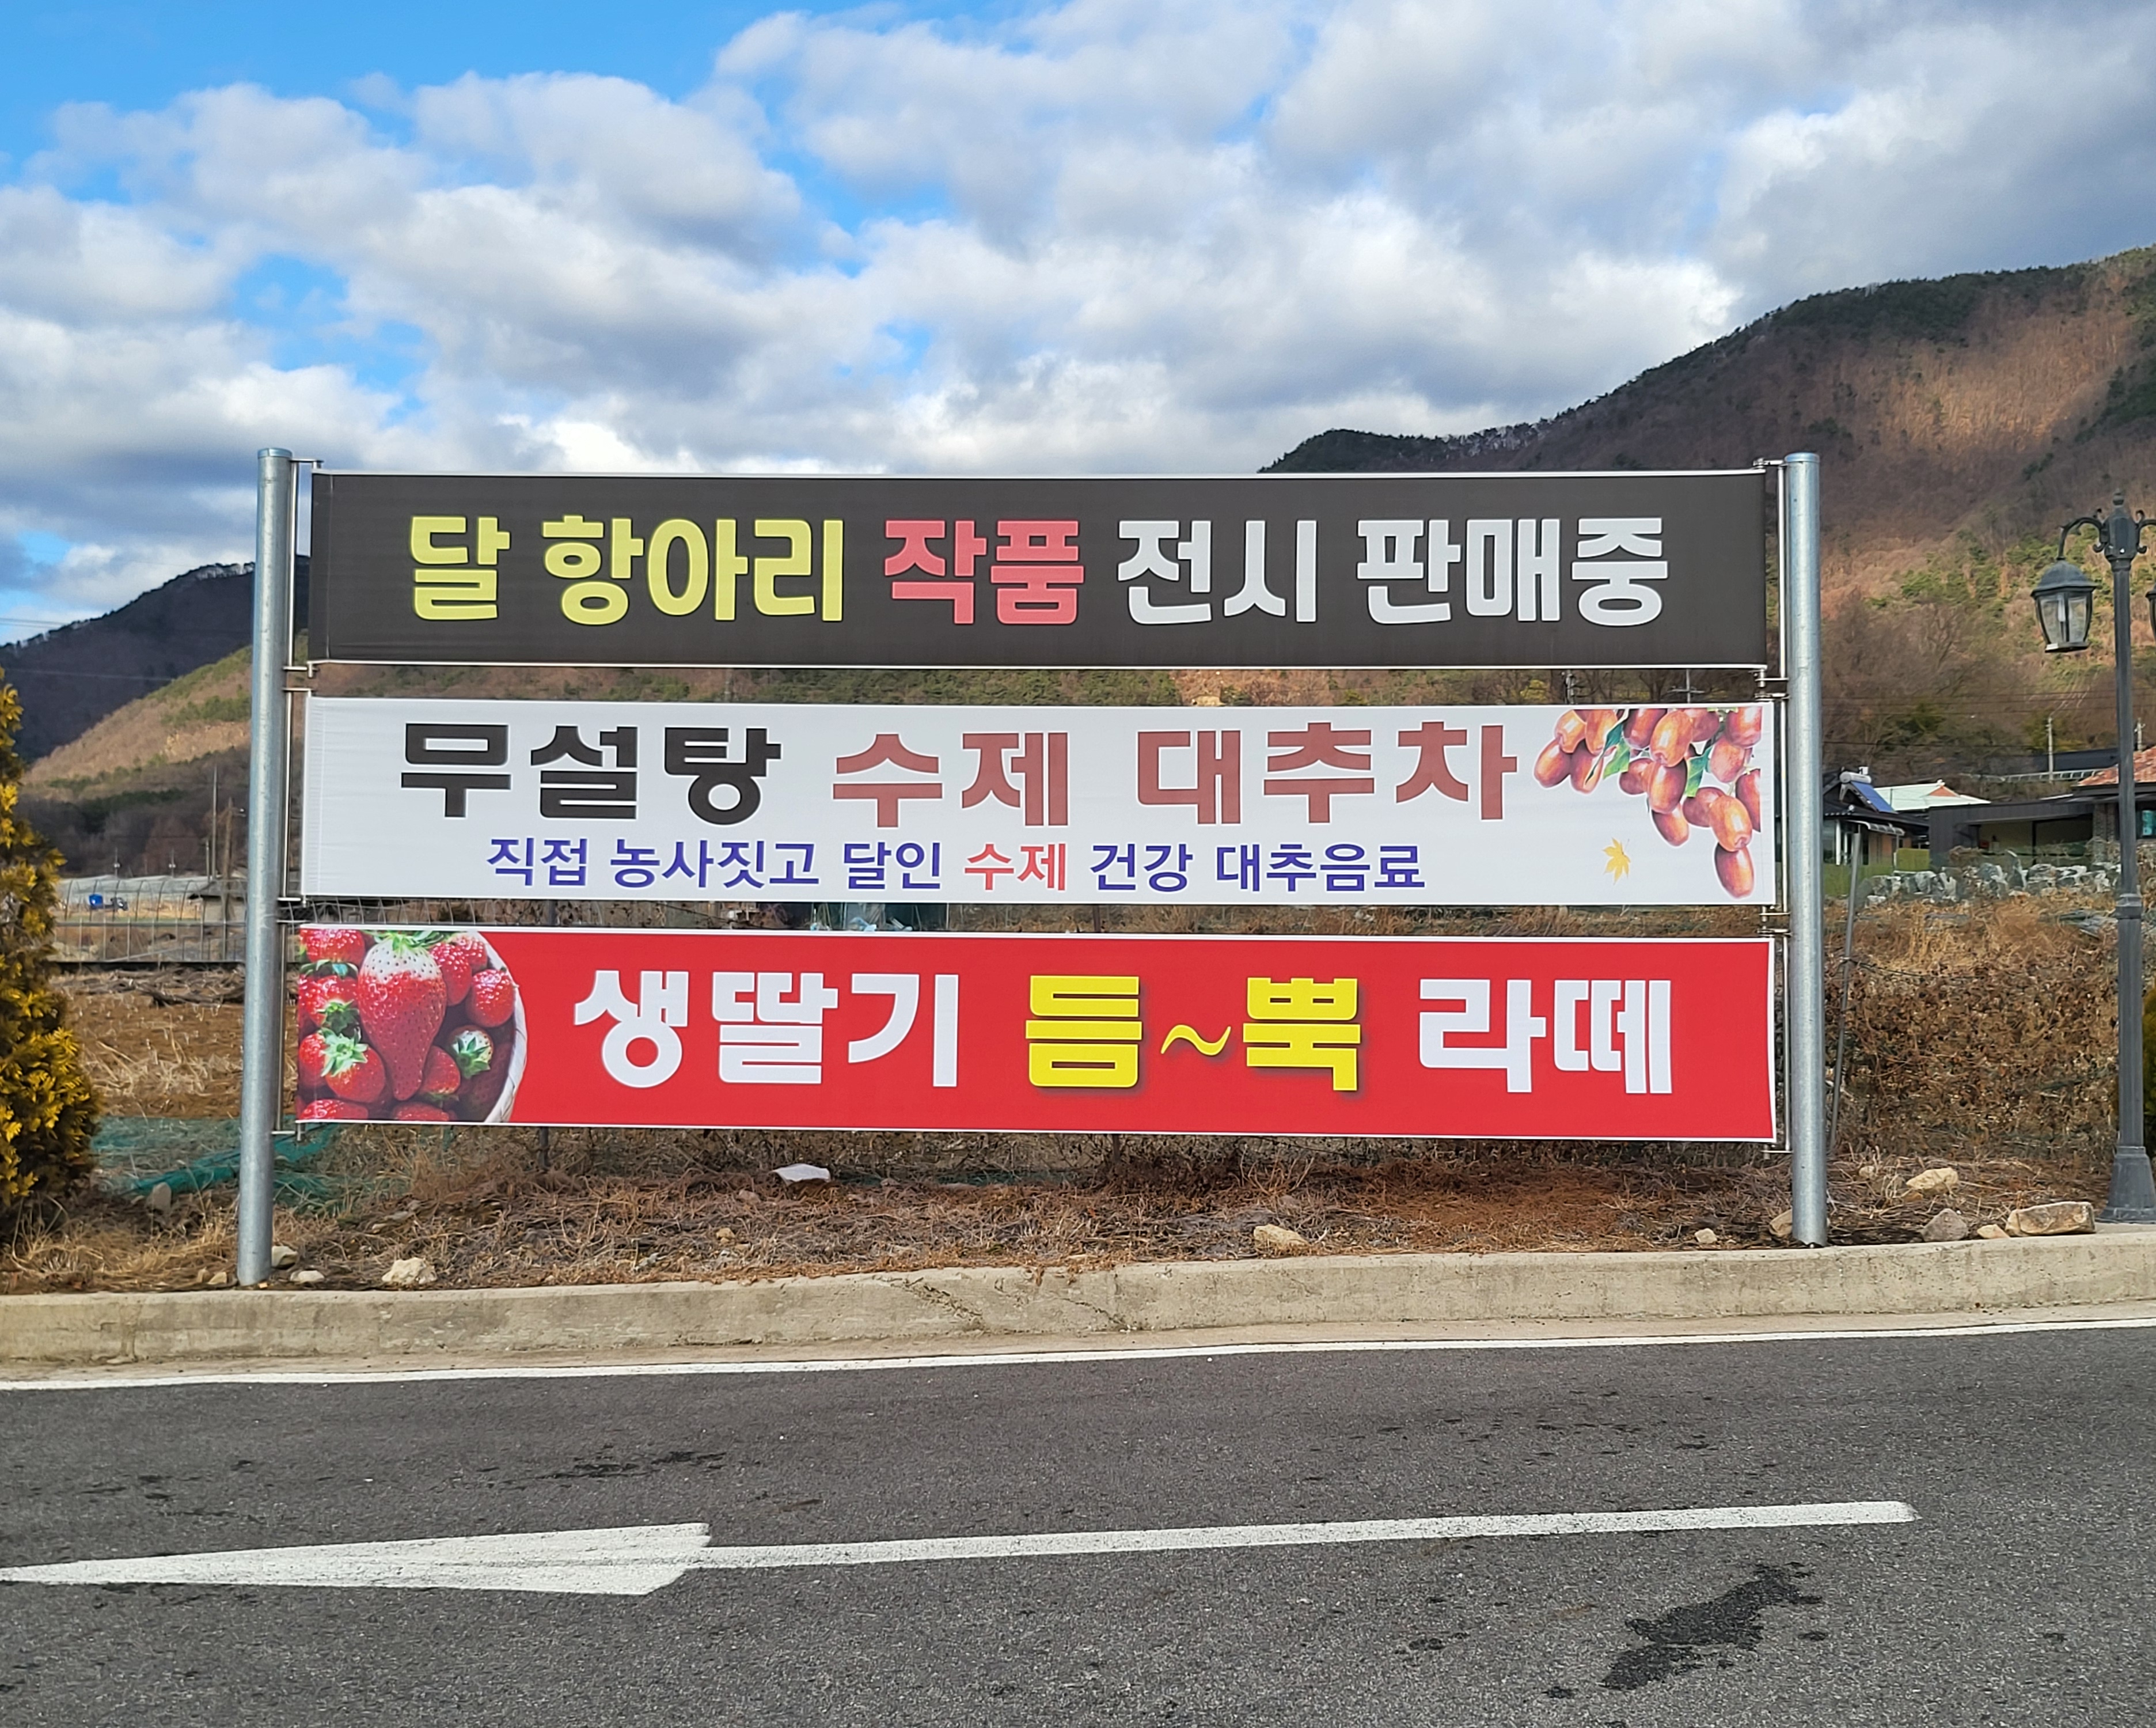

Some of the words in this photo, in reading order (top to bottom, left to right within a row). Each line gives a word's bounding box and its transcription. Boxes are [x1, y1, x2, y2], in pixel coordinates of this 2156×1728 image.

[411, 516, 511, 622] 달
[542, 515, 844, 626] 항아리
[885, 521, 1085, 626] 작품
[1117, 520, 1318, 626] 전시
[1356, 517, 1668, 627] 판매중
[401, 722, 783, 827] 무설탕
[833, 732, 1069, 829] 수제
[1136, 721, 1517, 825] 대추차
[488, 838, 587, 886] 직접
[610, 839, 819, 888] 농사짓고
[844, 842, 940, 889] 달인
[965, 844, 1065, 890] 수제
[1091, 844, 1193, 892] 건강
[1217, 844, 1425, 892] 대추음료
[574, 970, 958, 1087] 생딸기
[1026, 976, 1360, 1090] 듬~뿍
[1419, 979, 1672, 1093] 라떼
